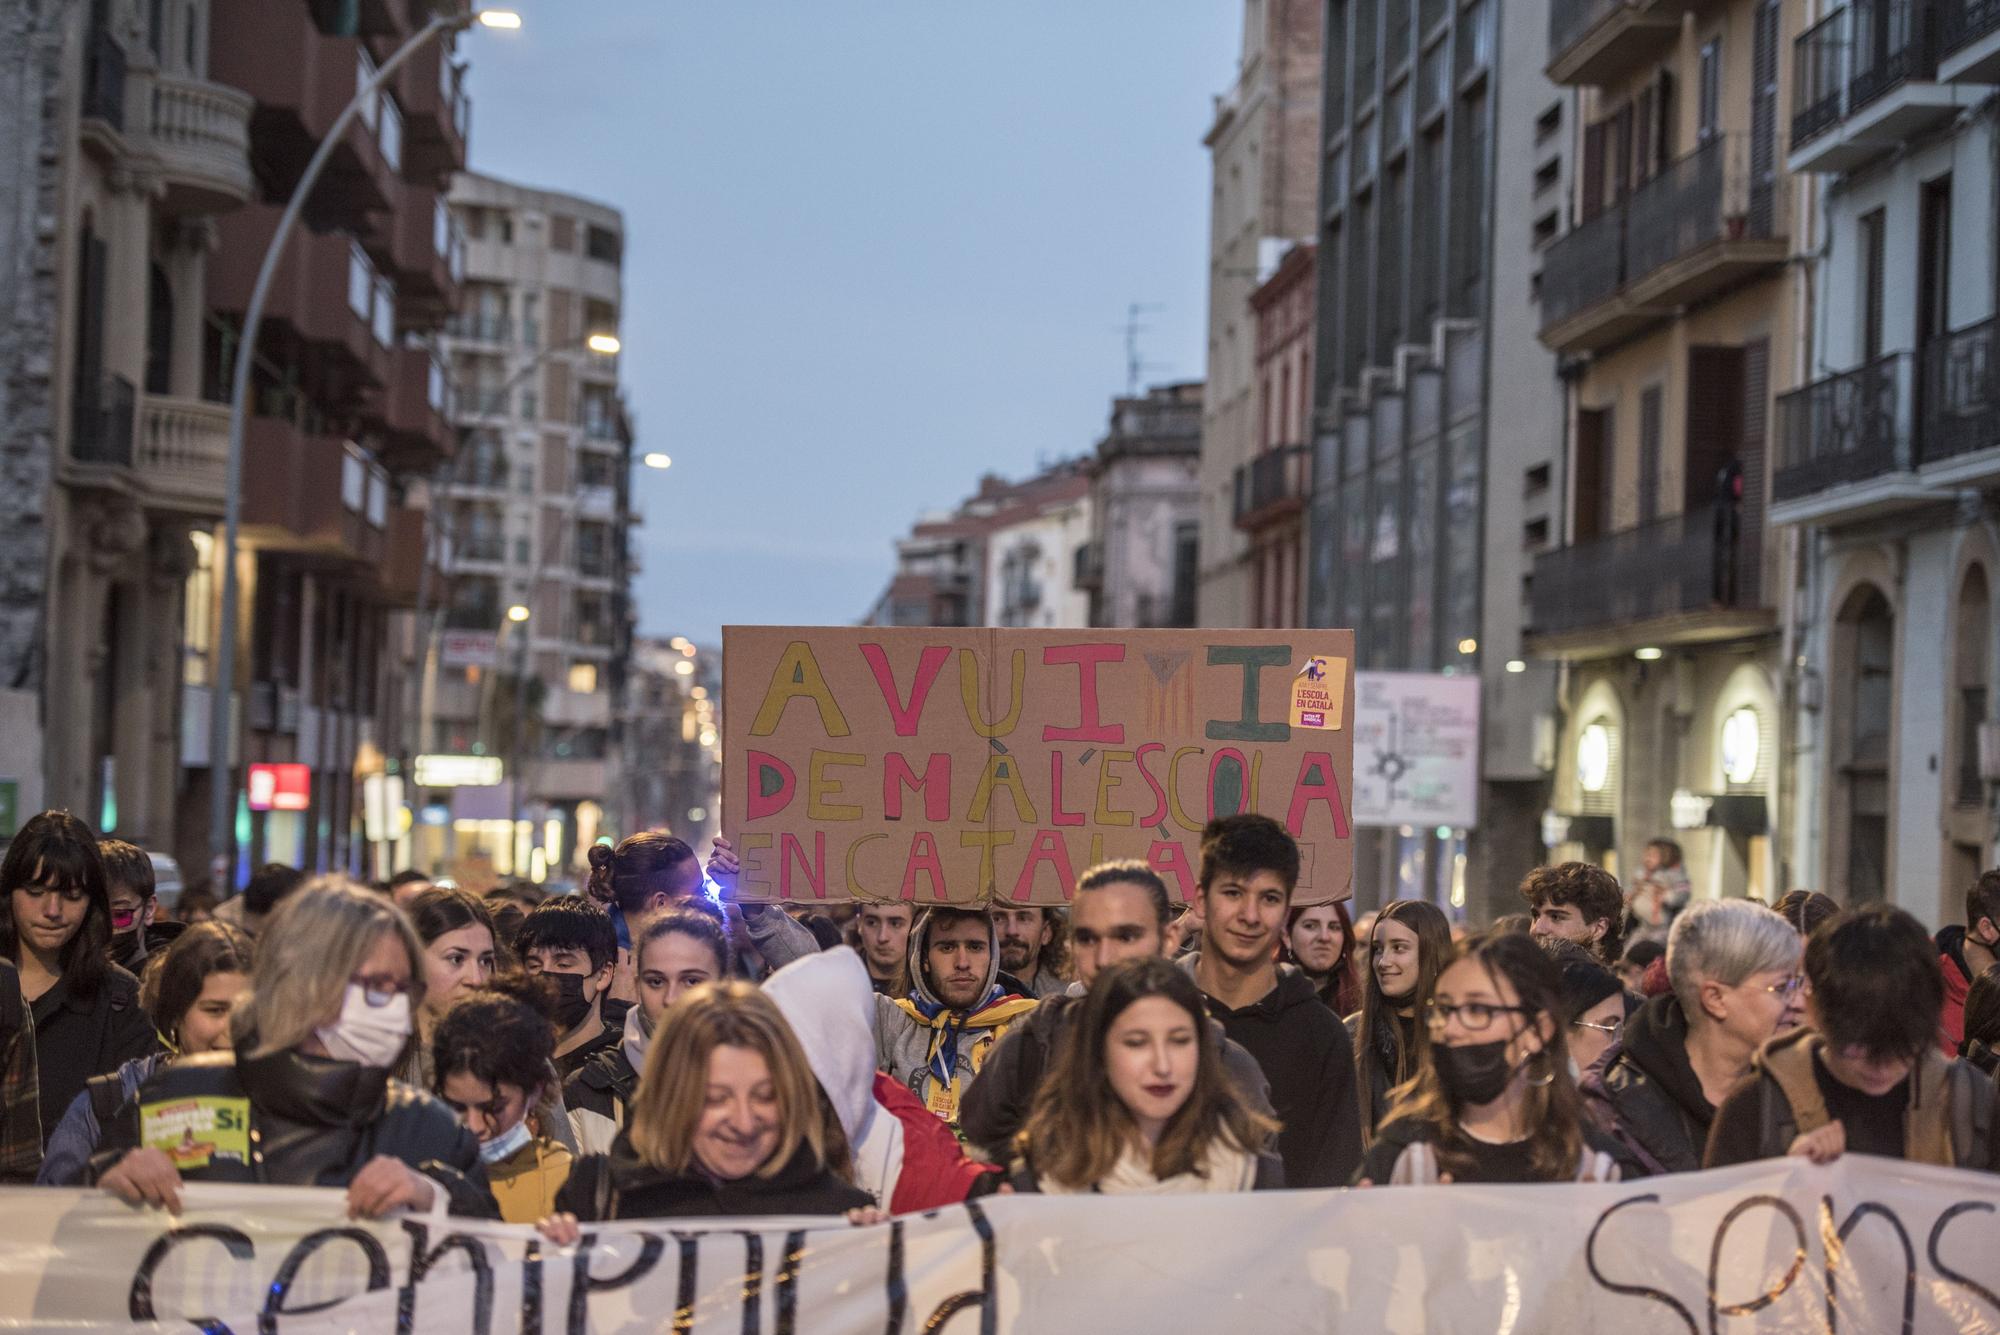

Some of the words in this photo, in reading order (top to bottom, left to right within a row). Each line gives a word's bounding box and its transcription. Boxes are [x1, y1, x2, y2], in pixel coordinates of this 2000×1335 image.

[748, 641, 1125, 744] AVUI
[1204, 645, 1291, 741] I
[1296, 699, 1306, 708] EN
[1307, 699, 1334, 710] CATALÀ
[1297, 689, 1329, 700] L'ESCOLA
[747, 739, 1037, 823] DEMÀ
[733, 831, 826, 899] EN
